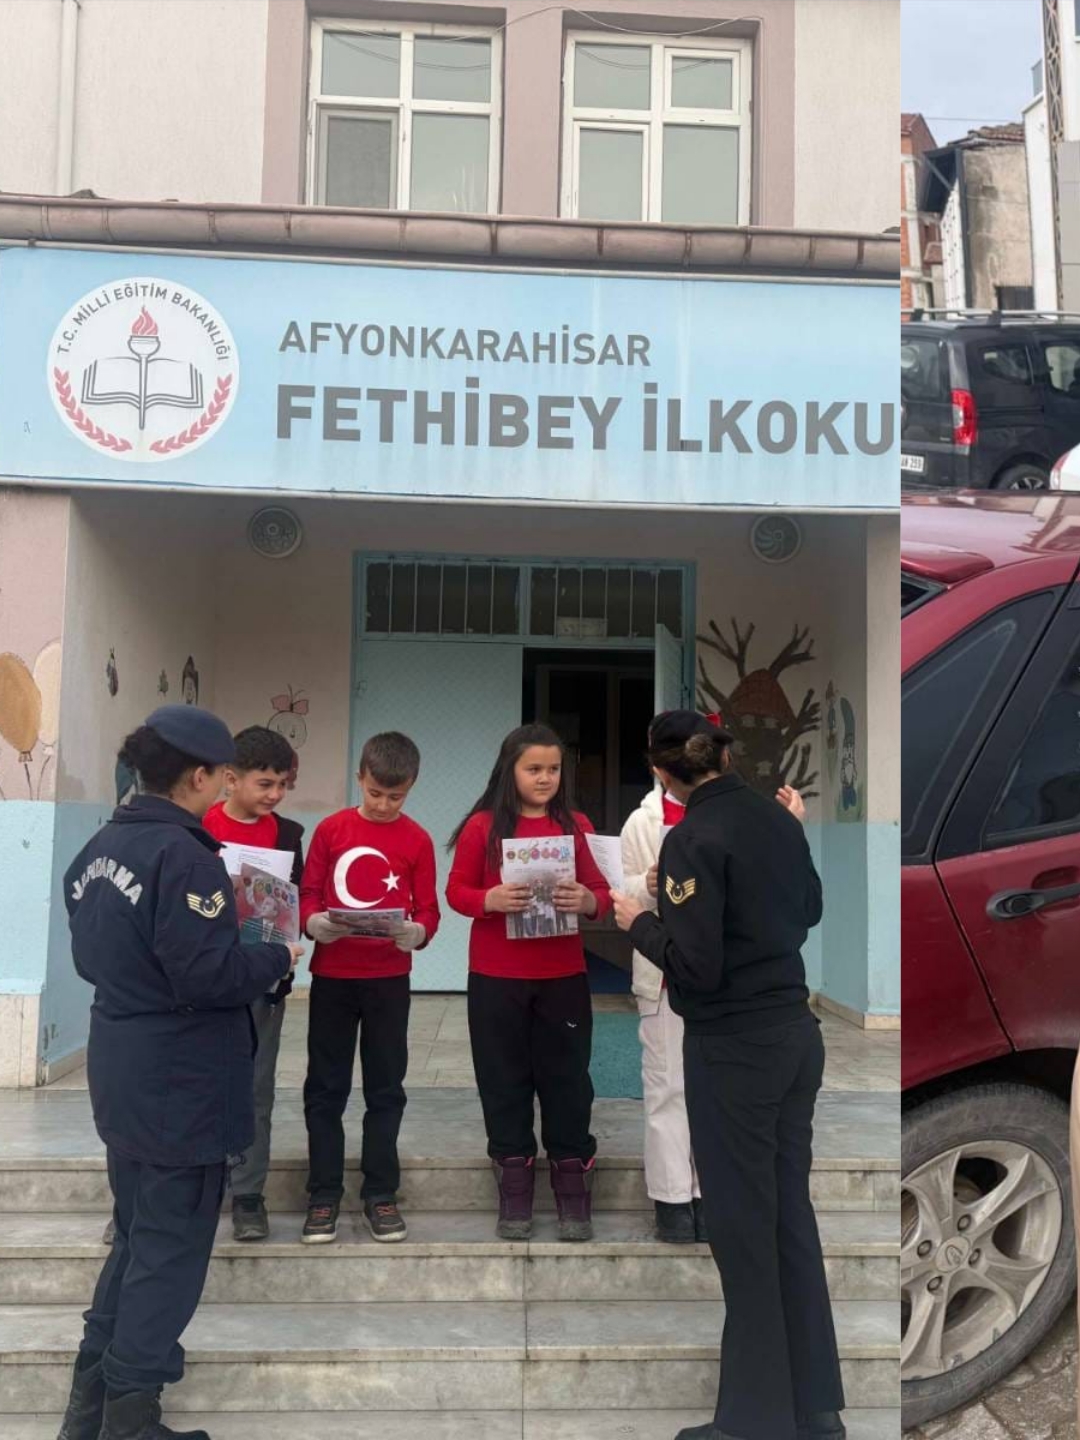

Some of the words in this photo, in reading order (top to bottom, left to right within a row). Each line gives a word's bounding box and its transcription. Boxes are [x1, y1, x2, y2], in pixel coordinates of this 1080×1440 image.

[57, 328, 79, 355] T.C.
[73, 290, 112, 326] MİLLİ
[114, 282, 168, 301] EĞİTİM
[171, 292, 231, 361] BAKANLIĞI
[278, 320, 651, 367] AFYONKARAHİSAR
[276, 376, 623, 451] FETHİBEY
[643, 381, 896, 456] İLKOKU
[71, 856, 143, 906] JANDARMA
